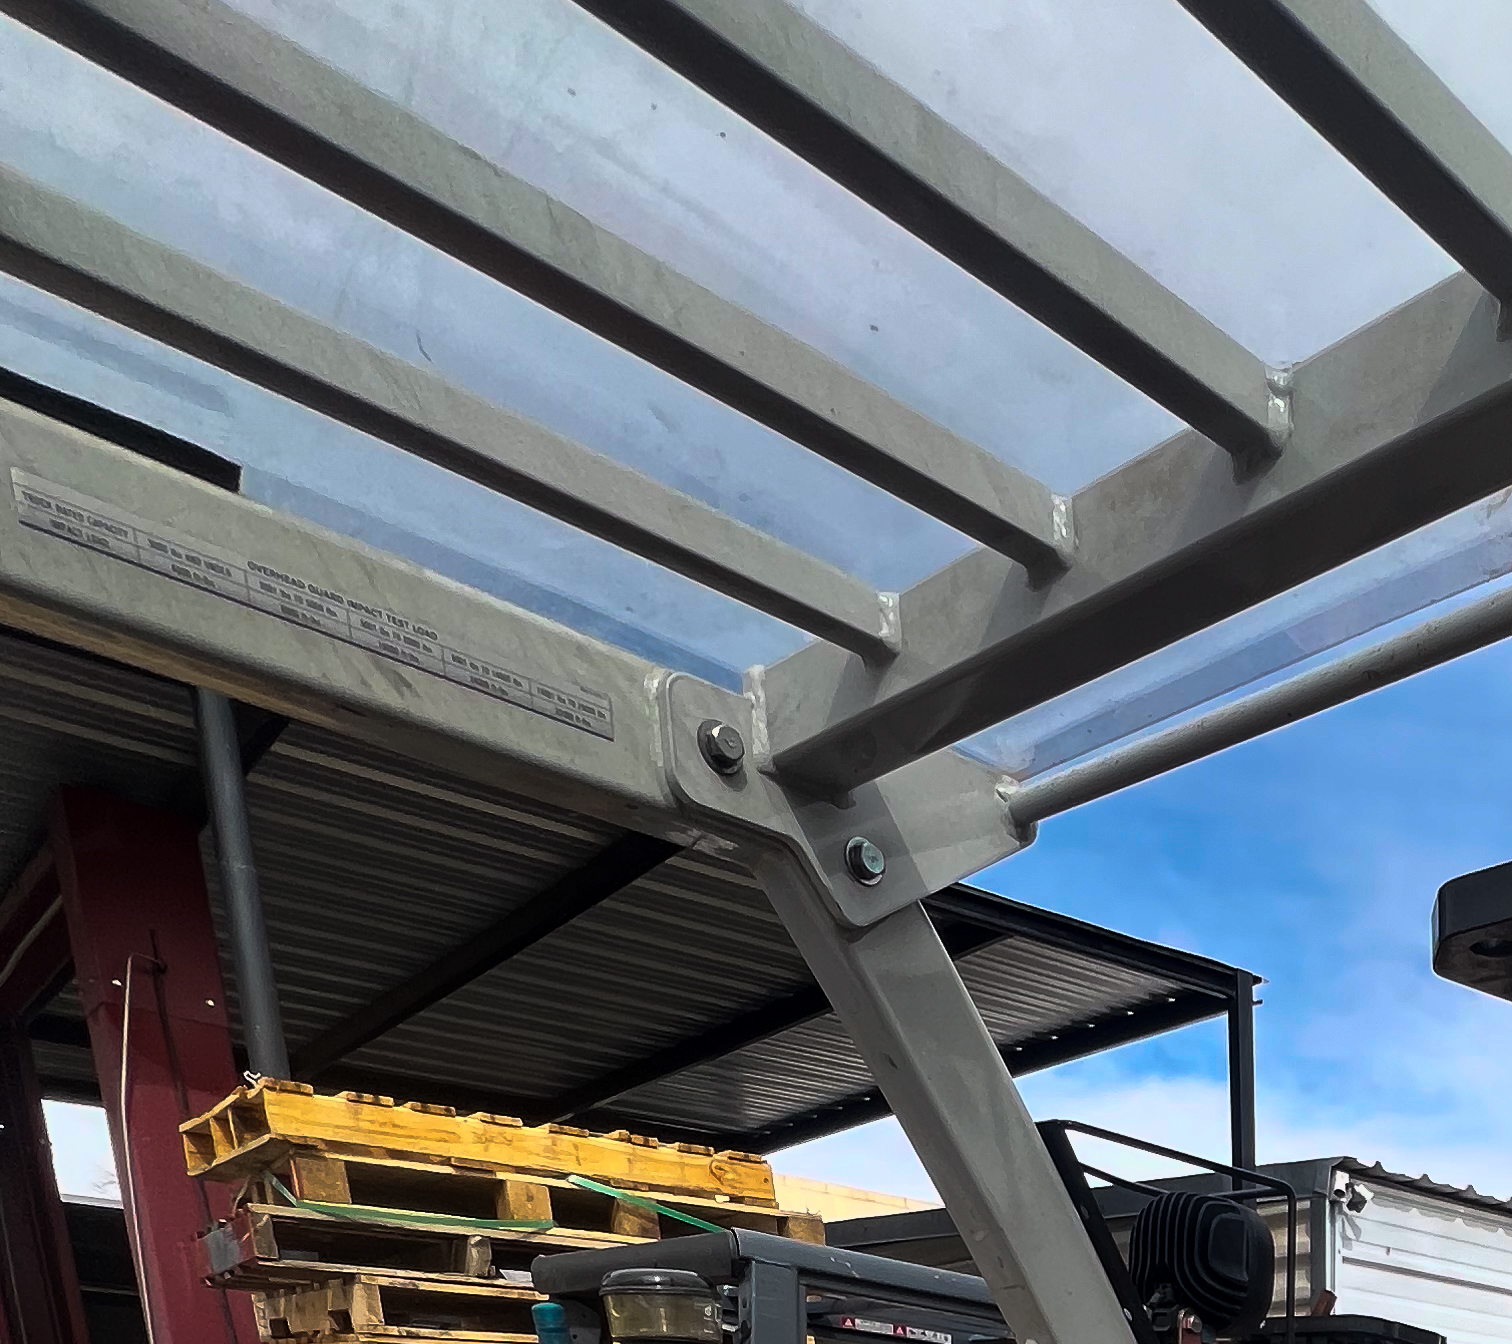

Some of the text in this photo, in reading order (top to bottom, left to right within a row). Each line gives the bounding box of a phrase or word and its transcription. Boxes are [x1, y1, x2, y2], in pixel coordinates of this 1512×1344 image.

[247, 560, 306, 590] OVERHEAD
[308, 583, 345, 604] GUARD
[385, 612, 409, 629] TEST
[412, 624, 438, 641] LOAD
